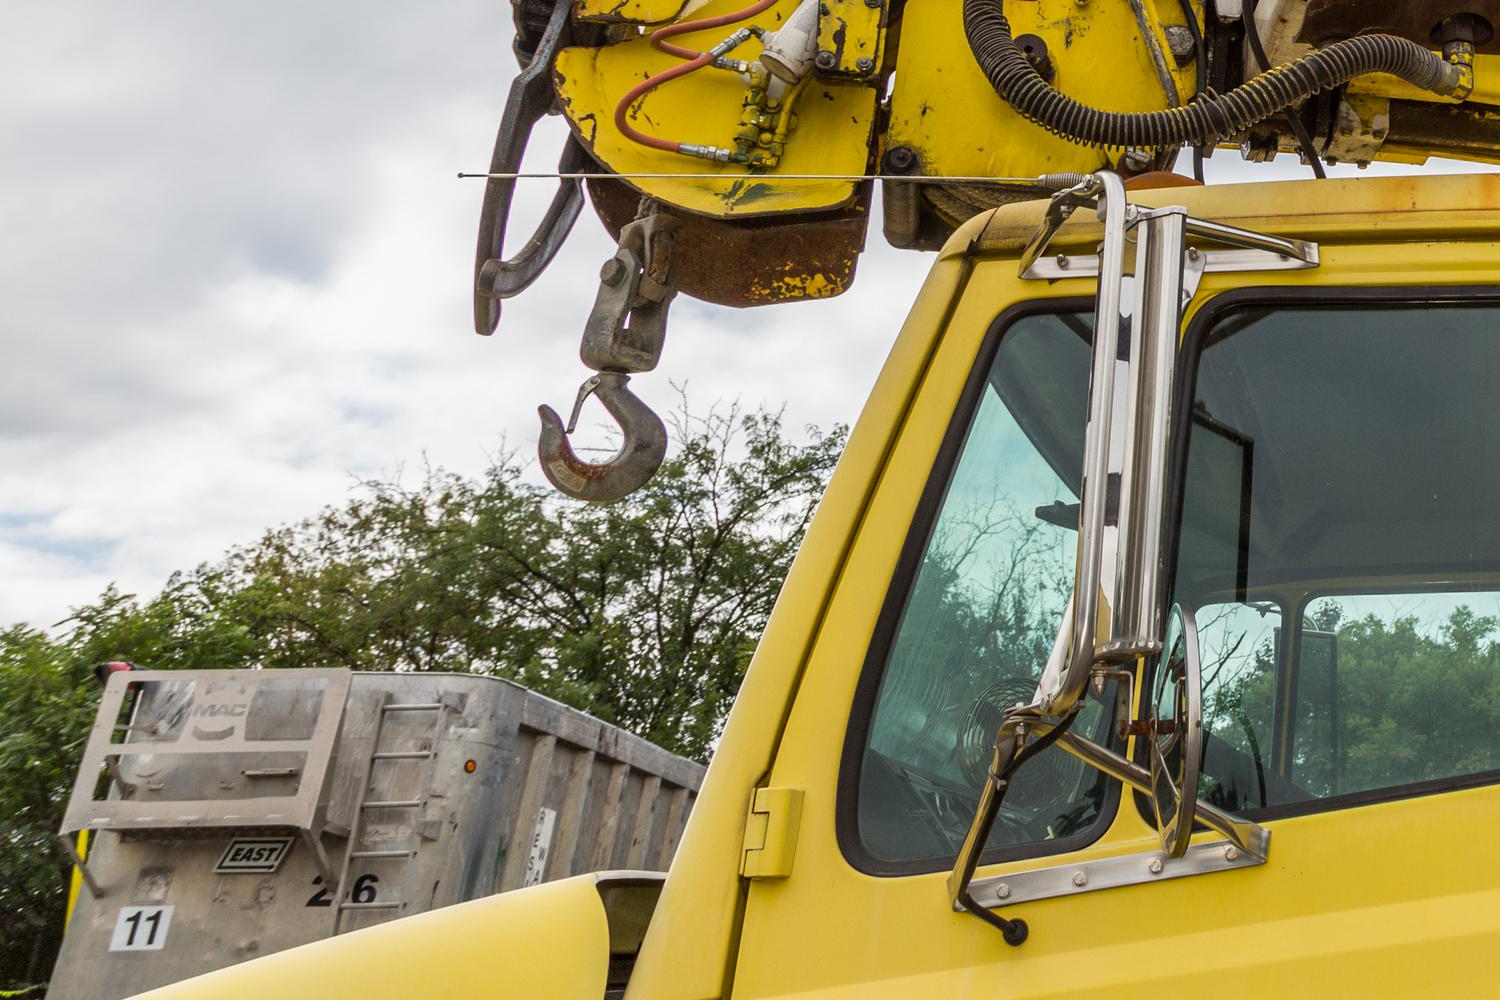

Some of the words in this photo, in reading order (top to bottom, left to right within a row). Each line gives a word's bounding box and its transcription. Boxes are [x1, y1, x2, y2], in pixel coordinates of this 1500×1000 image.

[192, 703, 248, 717] MAC
[229, 847, 278, 863] EAST
[126, 910, 163, 946] 11
